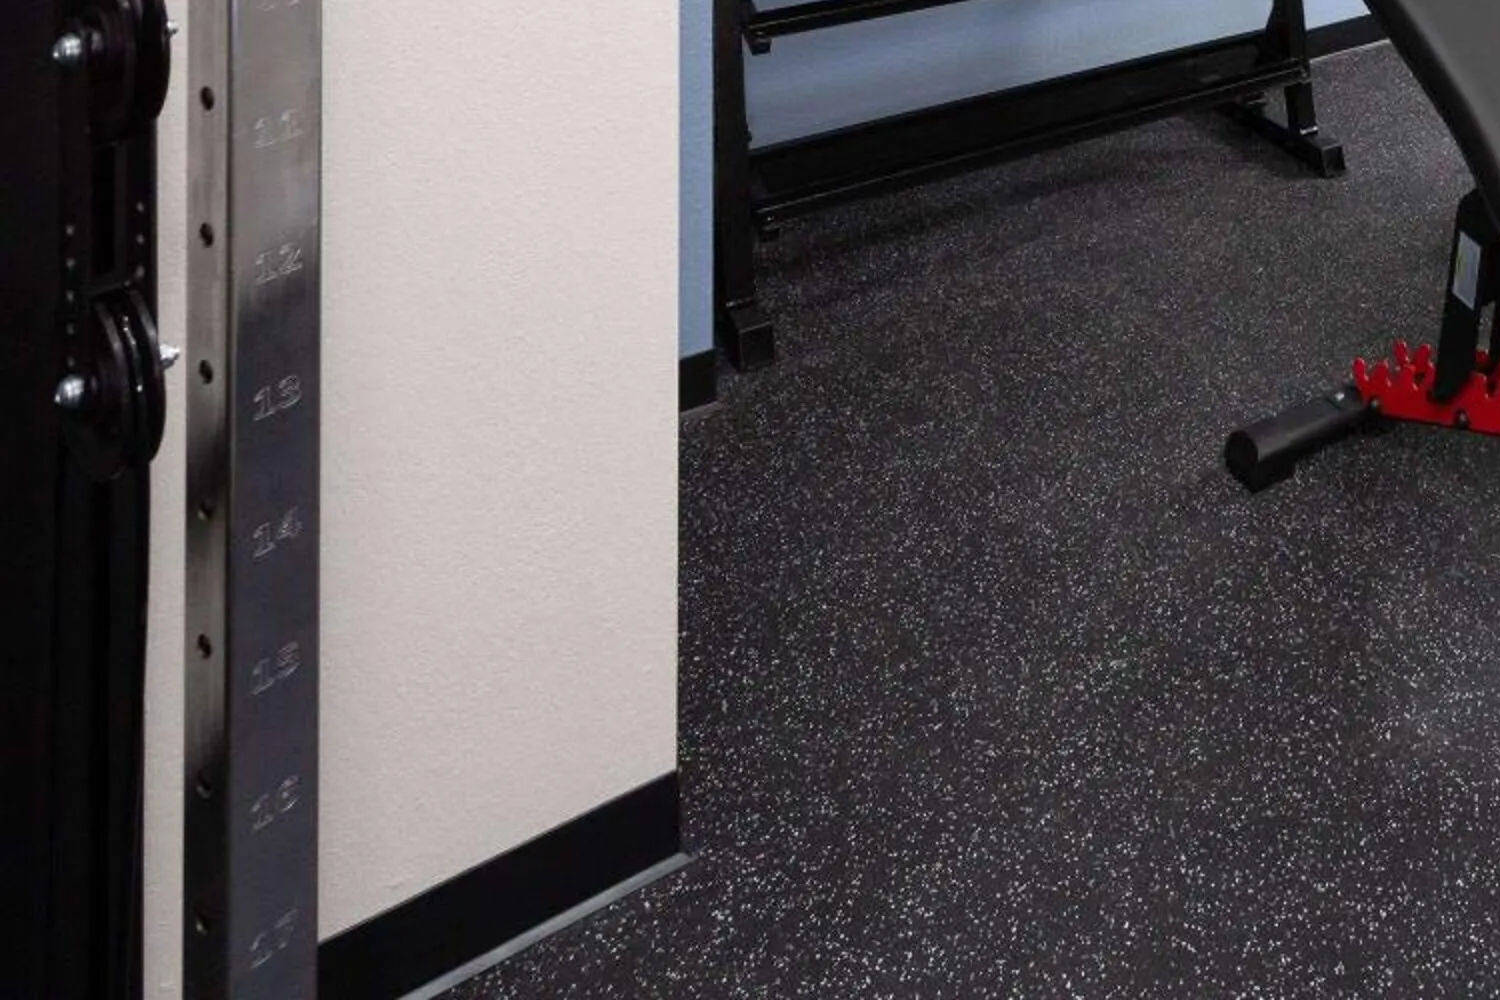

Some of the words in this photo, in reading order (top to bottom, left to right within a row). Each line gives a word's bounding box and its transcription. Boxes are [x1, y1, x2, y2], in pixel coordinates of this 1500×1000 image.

[255, 242, 303, 285] 12
[253, 374, 302, 421] 13
[252, 506, 303, 557] 14
[252, 641, 301, 695] 15
